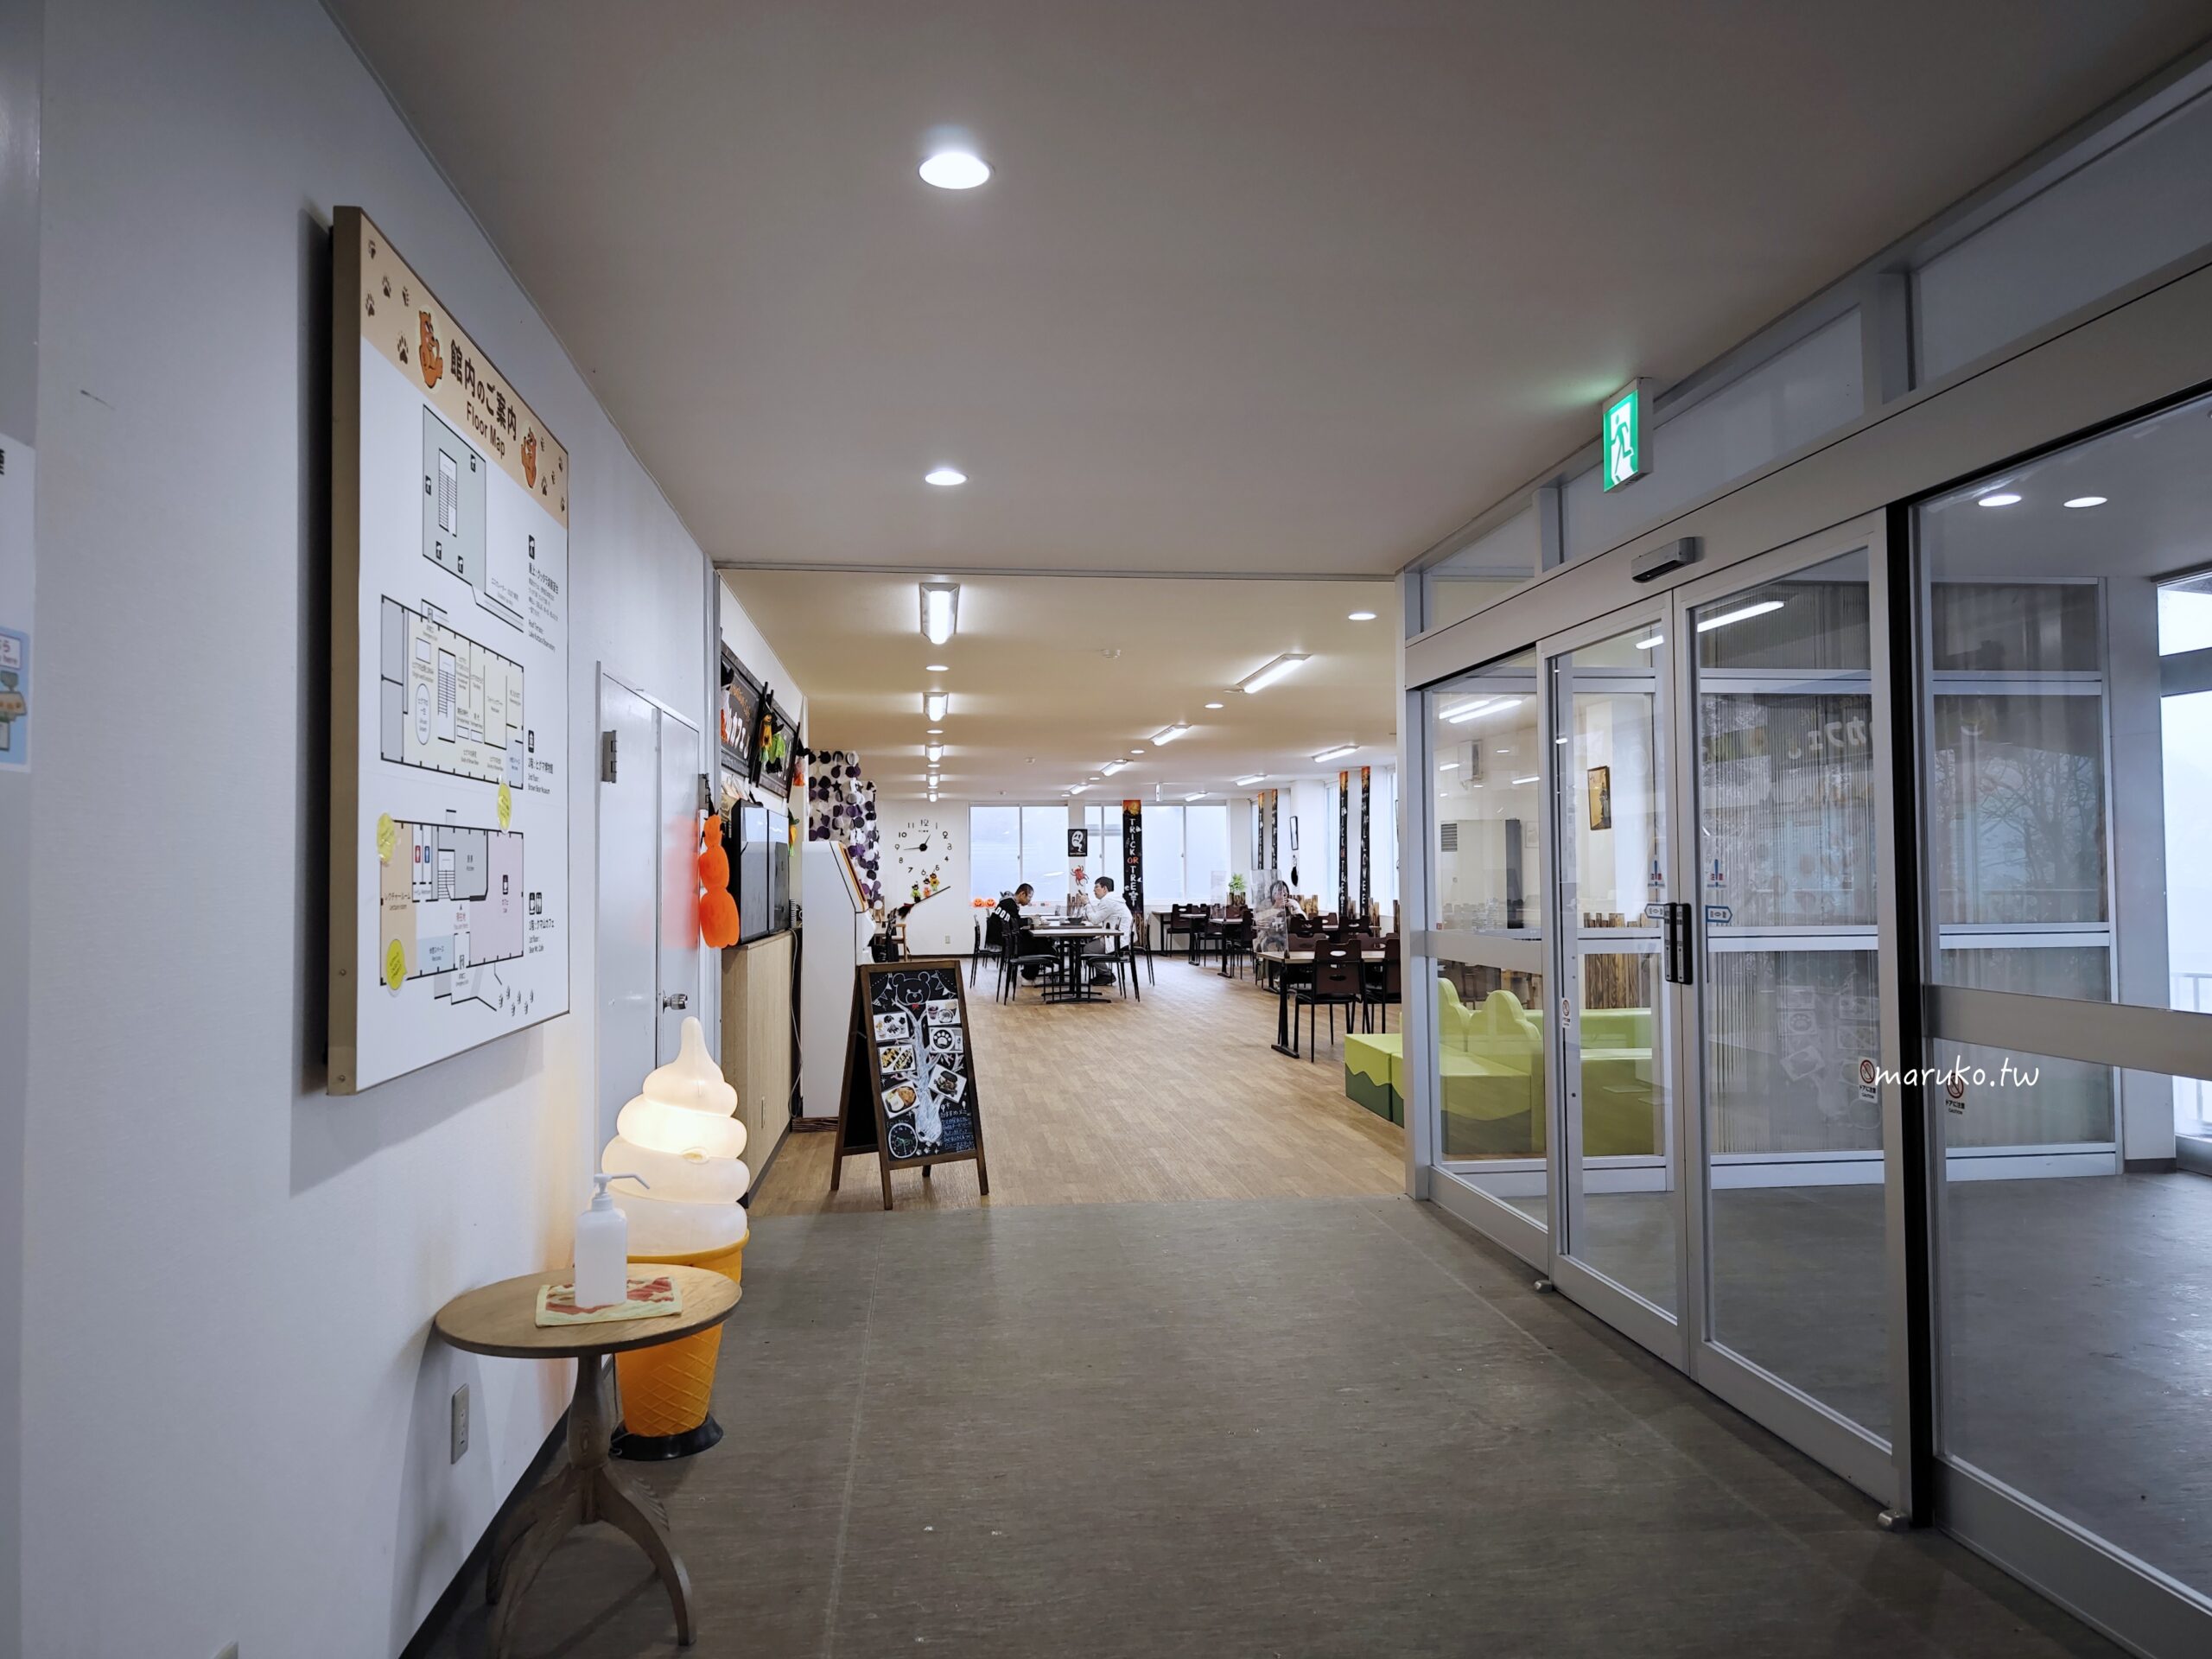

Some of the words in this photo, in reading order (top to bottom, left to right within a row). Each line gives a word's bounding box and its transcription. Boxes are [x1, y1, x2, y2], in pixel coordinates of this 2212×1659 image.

[450, 339, 517, 442] 館内のご案内
[467, 400, 488, 438] Floor
[489, 423, 505, 460] Map
[920, 818, 929, 827] 12
[942, 830, 949, 839] 2
[1128, 818, 1137, 856] TRICK
